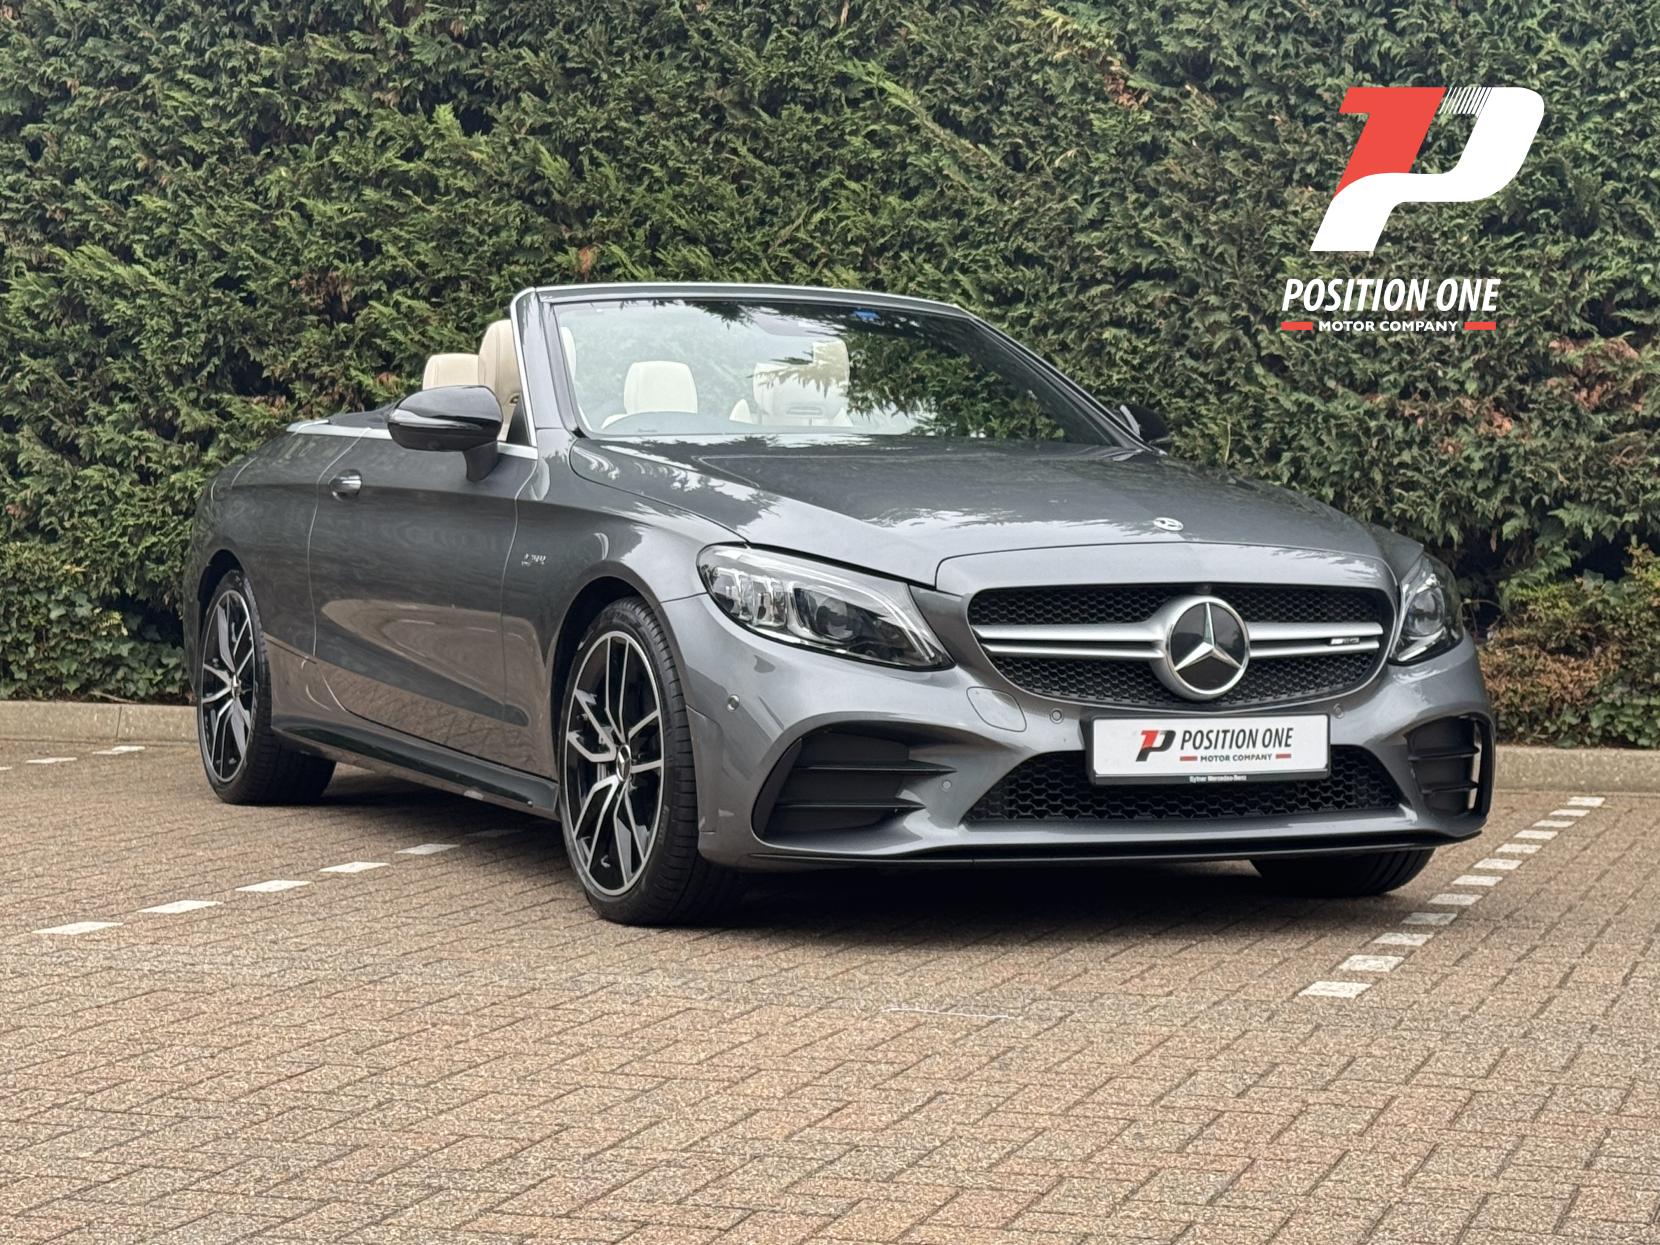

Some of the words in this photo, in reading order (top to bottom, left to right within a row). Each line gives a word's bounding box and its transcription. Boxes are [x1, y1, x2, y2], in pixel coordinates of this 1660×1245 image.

[1180, 729, 1259, 751] POSITION
[1261, 728, 1294, 749] ONE
[1232, 753, 1273, 761] COMPANY
